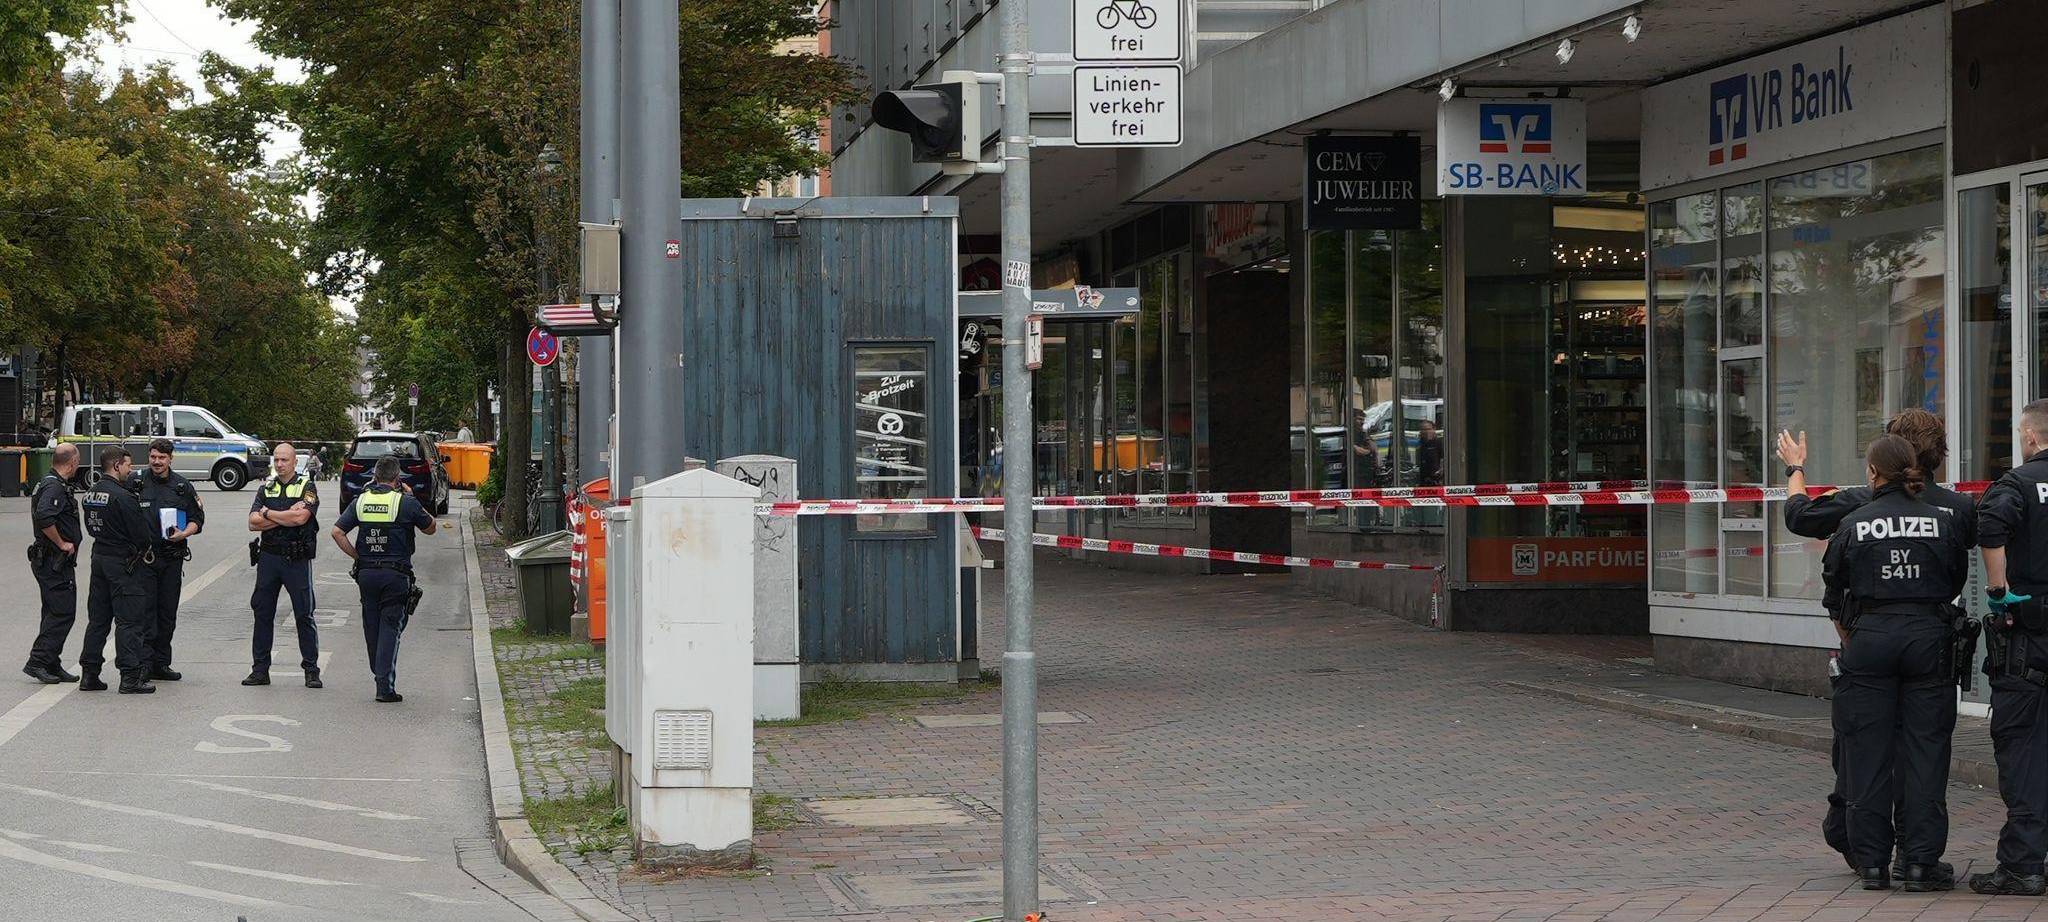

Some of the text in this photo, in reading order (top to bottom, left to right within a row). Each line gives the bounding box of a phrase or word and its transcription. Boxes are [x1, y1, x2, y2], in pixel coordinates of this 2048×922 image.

[1111, 35, 1144, 52] frei
[1093, 75, 1161, 92] Linien-
[1751, 46, 1853, 133] VR Bank
[1090, 97, 1165, 114] verkehr
[1112, 119, 1144, 136] frei
[1316, 152, 1361, 172] CEM
[1449, 162, 1582, 190] SB-BANK
[1314, 180, 1414, 204] JUWELIER
[869, 379, 915, 401] Brotzeit
[880, 375, 902, 388] Zur
[363, 504, 389, 513] POLIZEI
[370, 528, 381, 537] BY
[1856, 516, 1940, 542] POLIZEI
[1543, 546, 1646, 567] PARFÜME
[1890, 549, 1911, 564] BY
[1881, 564, 1921, 580] 5411
